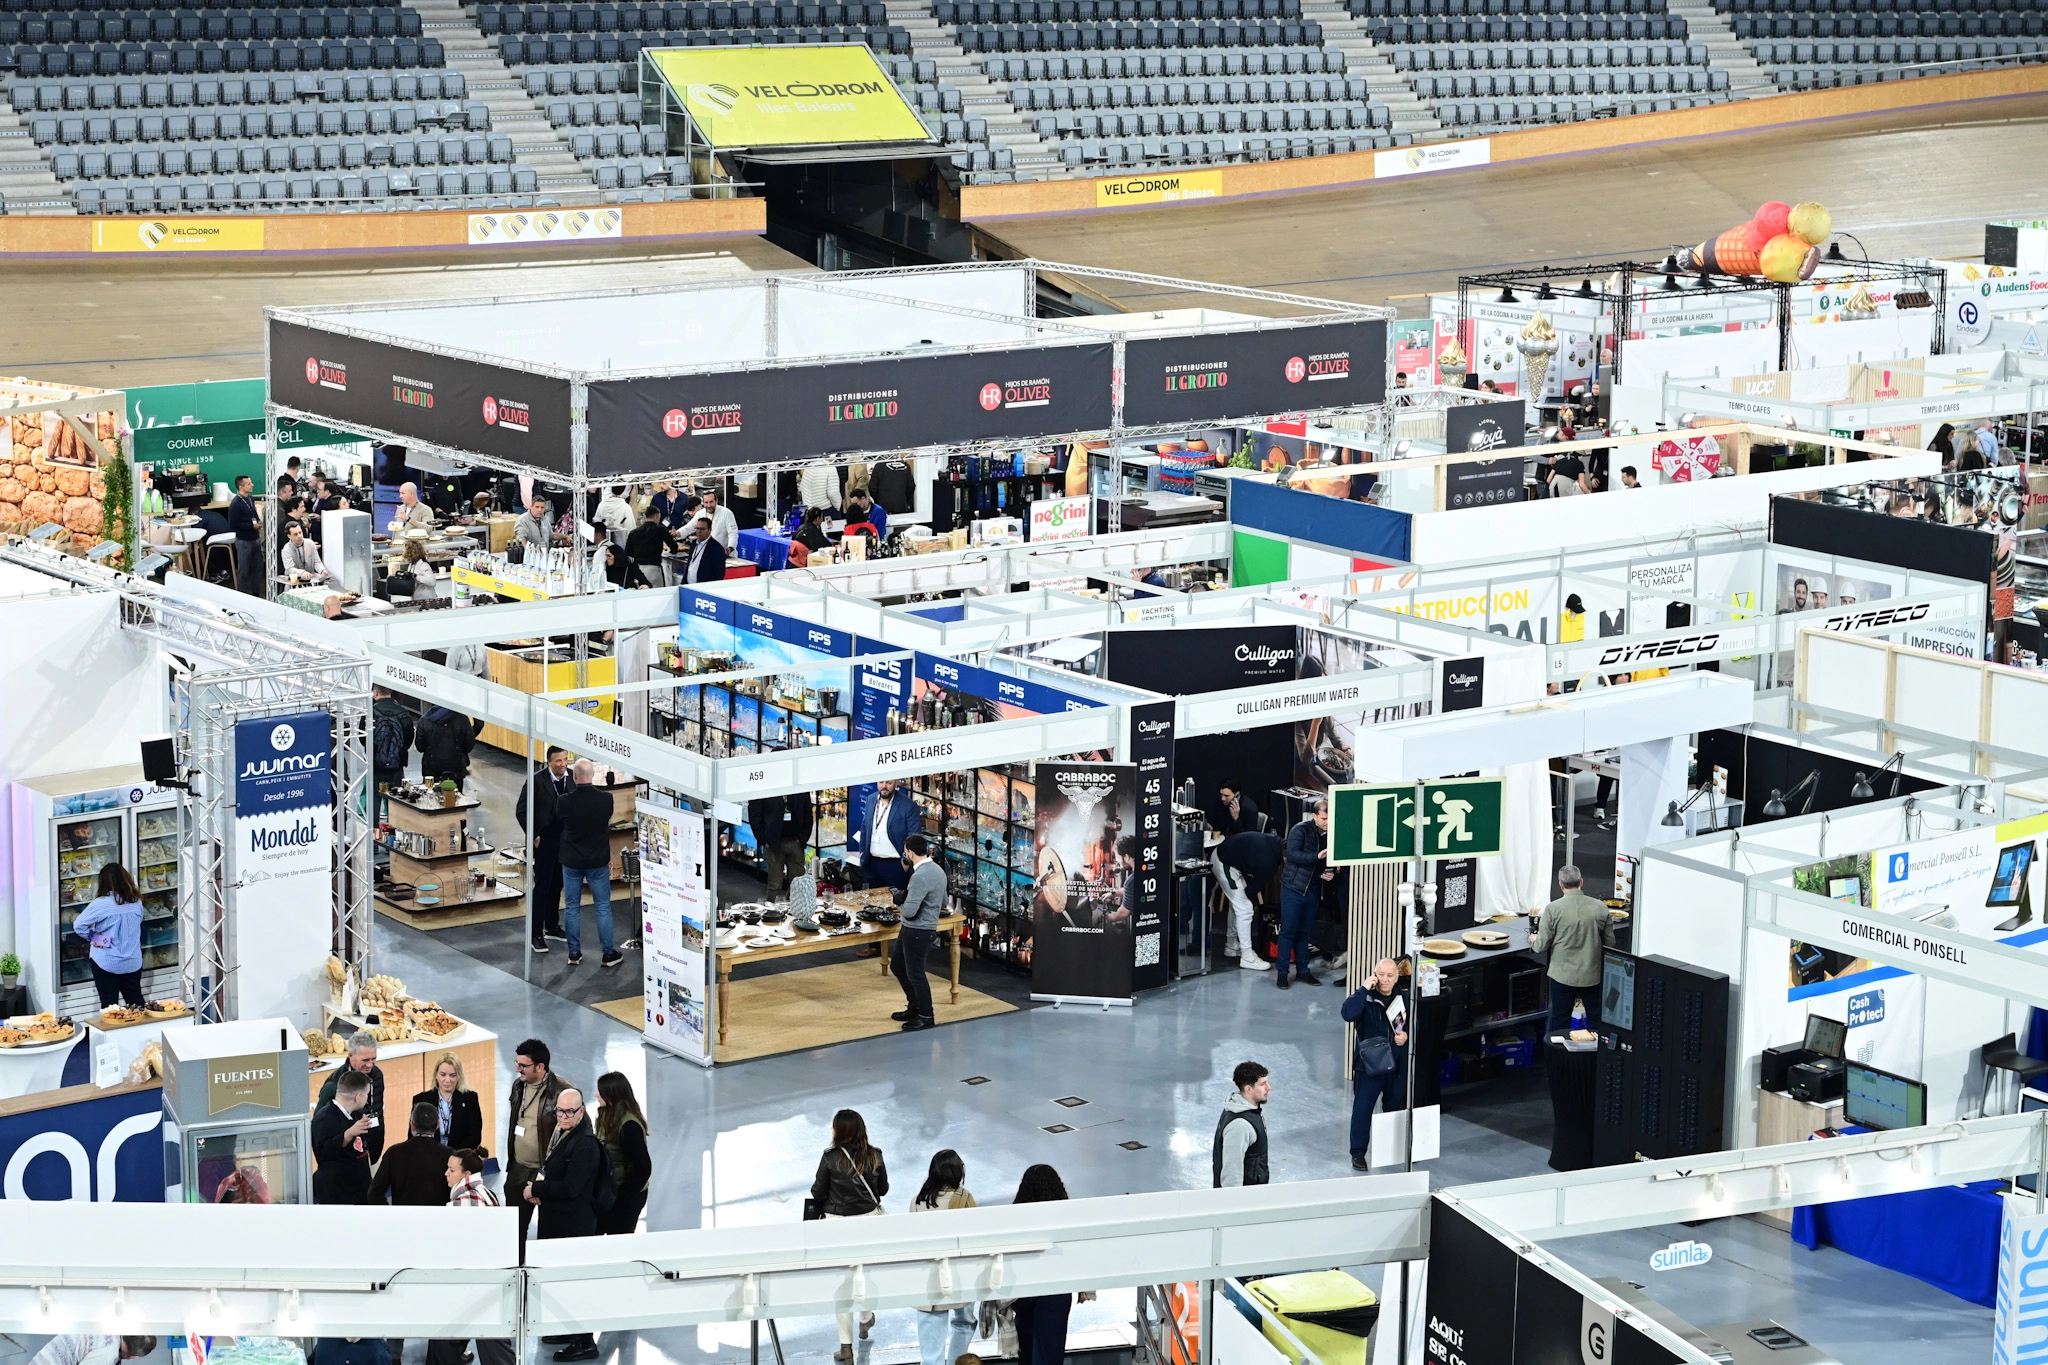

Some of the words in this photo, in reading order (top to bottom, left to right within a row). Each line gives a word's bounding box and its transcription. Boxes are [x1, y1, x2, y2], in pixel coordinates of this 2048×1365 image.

[744, 81, 884, 99] VELÒDROM
[757, 102, 794, 114] Illes
[796, 99, 857, 113] Balears
[1104, 178, 1180, 196] VELÒDROM
[1162, 190, 1181, 201] Illes
[1182, 188, 1215, 200] Balears
[1659, 316, 1665, 324] LA
[1666, 315, 1683, 323] COCINA
[1695, 313, 1714, 321] HUERTA
[1956, 324, 1979, 333] tindale
[307, 361, 318, 379] HR
[1165, 361, 1228, 373] DISTRIBUCIONES
[1288, 362, 1304, 378] HR
[1308, 359, 1350, 375] OLIVER
[320, 368, 347, 385] OLIVER
[392, 374, 434, 390] DISTRIBUCIONES
[1005, 381, 1021, 389] HIJOS
[829, 390, 898, 402] DISTRIBUCIONES
[982, 388, 1001, 405] HR
[1005, 385, 1051, 402] OLIVER
[1874, 388, 1899, 399] Templo
[485, 402, 497, 420] HR
[499, 405, 530, 426] OLIVER
[691, 406, 708, 415] HIJOS
[717, 403, 741, 411] RAMÓN
[1728, 401, 1751, 413] TEMPLO
[1752, 403, 1771, 415] CAFES
[1921, 404, 1942, 415] TEMPLO
[1943, 403, 1960, 412] CAFES
[666, 415, 687, 432] HR
[691, 411, 743, 429] OLIVER
[167, 436, 214, 450] GOURMET
[1034, 501, 1086, 527] negrini
[1032, 531, 1059, 542] negrini
[1062, 528, 1088, 540] negrini
[1631, 563, 1693, 580] PERSONALIZA
[1639, 579, 1650, 588] TU
[1653, 574, 1684, 588] MARCA
[695, 598, 716, 613] APS
[1141, 605, 1175, 616] YACHTING
[752, 614, 773, 630] APS
[1825, 603, 1930, 632] DYRECO
[808, 630, 831, 646] APS
[1599, 633, 1720, 666] DYRECO
[1911, 635, 1974, 659] IMPRESIÓN
[1235, 644, 1295, 667] Culligan
[1554, 659, 1562, 668] L5
[385, 664, 398, 678] APS
[398, 668, 427, 688] BALEARES
[934, 663, 959, 681] APS
[1448, 673, 1478, 687] Culligan
[868, 677, 894, 692] Baleares
[998, 681, 1025, 699] APS
[1237, 698, 1281, 715] CULLIGAN
[1284, 690, 1327, 708] PREMIUM
[1329, 687, 1359, 702] WATER
[1138, 720, 1171, 735] Culligan
[584, 732, 598, 747] APS
[599, 736, 631, 758] BALEARES
[877, 751, 898, 765] APS
[901, 743, 953, 761] BALEARES
[1146, 757, 1159, 766] agua
[1147, 761, 1168, 770] estrellas
[286, 773, 311, 782] EMBUTITS
[749, 770, 764, 782] A59
[1055, 772, 1117, 783] CABRABOC
[1145, 779, 1160, 794] 45
[263, 792, 285, 802] Desde
[286, 789, 304, 799] 1996
[1144, 813, 1159, 830] 83
[251, 817, 319, 853] Mondat
[262, 850, 288, 861] Siempre
[289, 849, 297, 857] de
[297, 848, 309, 858] hoy
[1143, 846, 1159, 862] 96
[1897, 856, 1938, 875] Comercial
[1939, 849, 1967, 866] Ponsell
[1968, 844, 1983, 859] S.L.
[274, 871, 289, 880] Enjoy
[290, 869, 299, 878] the
[1143, 878, 1157, 893] 10
[1136, 919, 1147, 928] ellos
[1147, 917, 1161, 926] ahora.
[1139, 912, 1154, 921] Únete
[1061, 926, 1104, 934] CABRABOC.COM
[1842, 919, 1910, 950] COMERCIAL
[1913, 937, 1968, 966] PONSELL
[1849, 995, 1870, 1011] Cash
[213, 1067, 275, 1084] FUENTES
[1654, 1243, 1705, 1269] suinla
[1429, 1315, 1464, 1352] AQUÍ
[1429, 1337, 1447, 1363] SE
